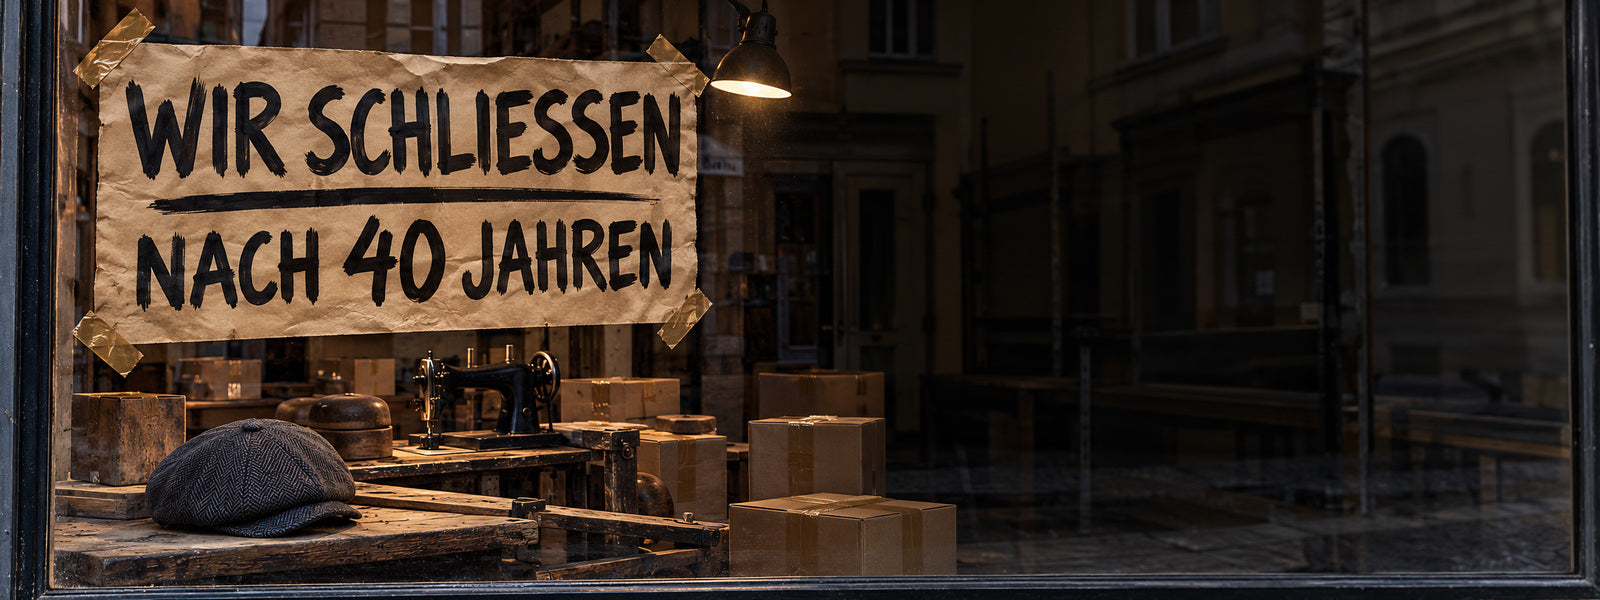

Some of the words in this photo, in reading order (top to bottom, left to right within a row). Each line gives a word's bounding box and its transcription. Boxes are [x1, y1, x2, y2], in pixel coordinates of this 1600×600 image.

[126, 77, 287, 180] WIR
[305, 84, 681, 178] SCHLIESSEN
[136, 227, 320, 312] NACH
[342, 215, 447, 307] 40
[461, 219, 673, 301] JAHREN
